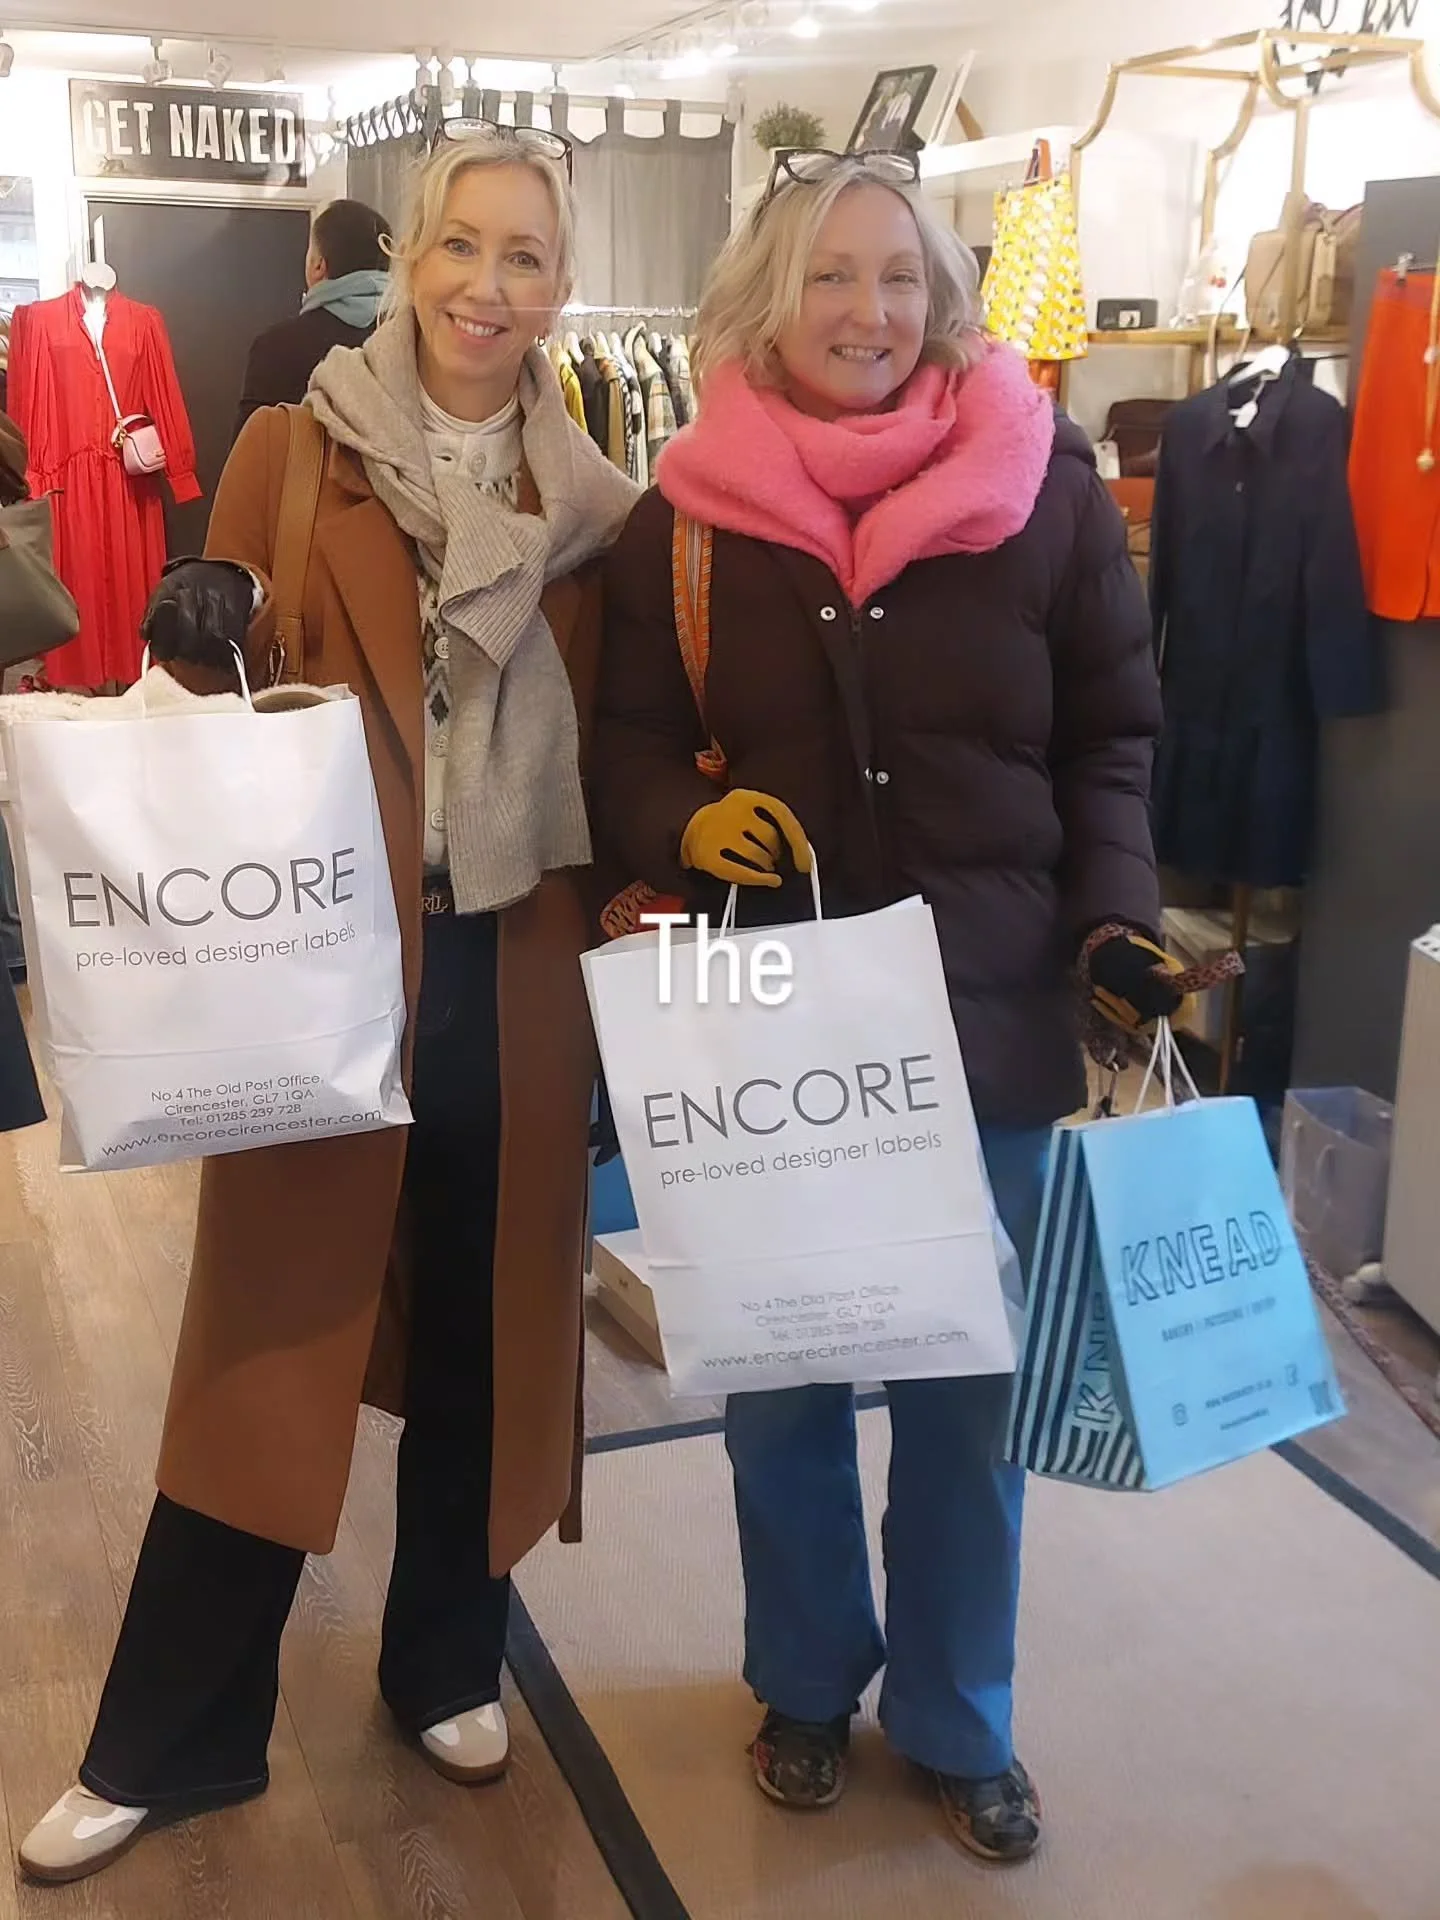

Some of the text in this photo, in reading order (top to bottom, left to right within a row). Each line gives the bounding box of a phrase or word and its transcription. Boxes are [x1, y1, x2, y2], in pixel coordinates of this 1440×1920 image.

[82, 99, 296, 164] GET NAKED
[64, 848, 355, 927] ENCORE
[77, 921, 356, 972] pre-loved designer labels
[151, 1090, 172, 1102] No
[176, 1089, 184, 1100] 4
[186, 1087, 212, 1099] The
[216, 1081, 241, 1095] Old
[245, 1079, 273, 1092] Post
[206, 1110, 247, 1124] 01285
[250, 1107, 274, 1119] 239
[277, 1103, 302, 1115] 728
[252, 1092, 279, 1105] GL7
[286, 1089, 315, 1101] 1QA
[643, 1053, 940, 1149] ENCORE
[101, 1109, 382, 1157] www.encorecirencester.com
[660, 1129, 942, 1190] pre-loved designer labels
[1121, 1210, 1280, 1307] KNEAD
